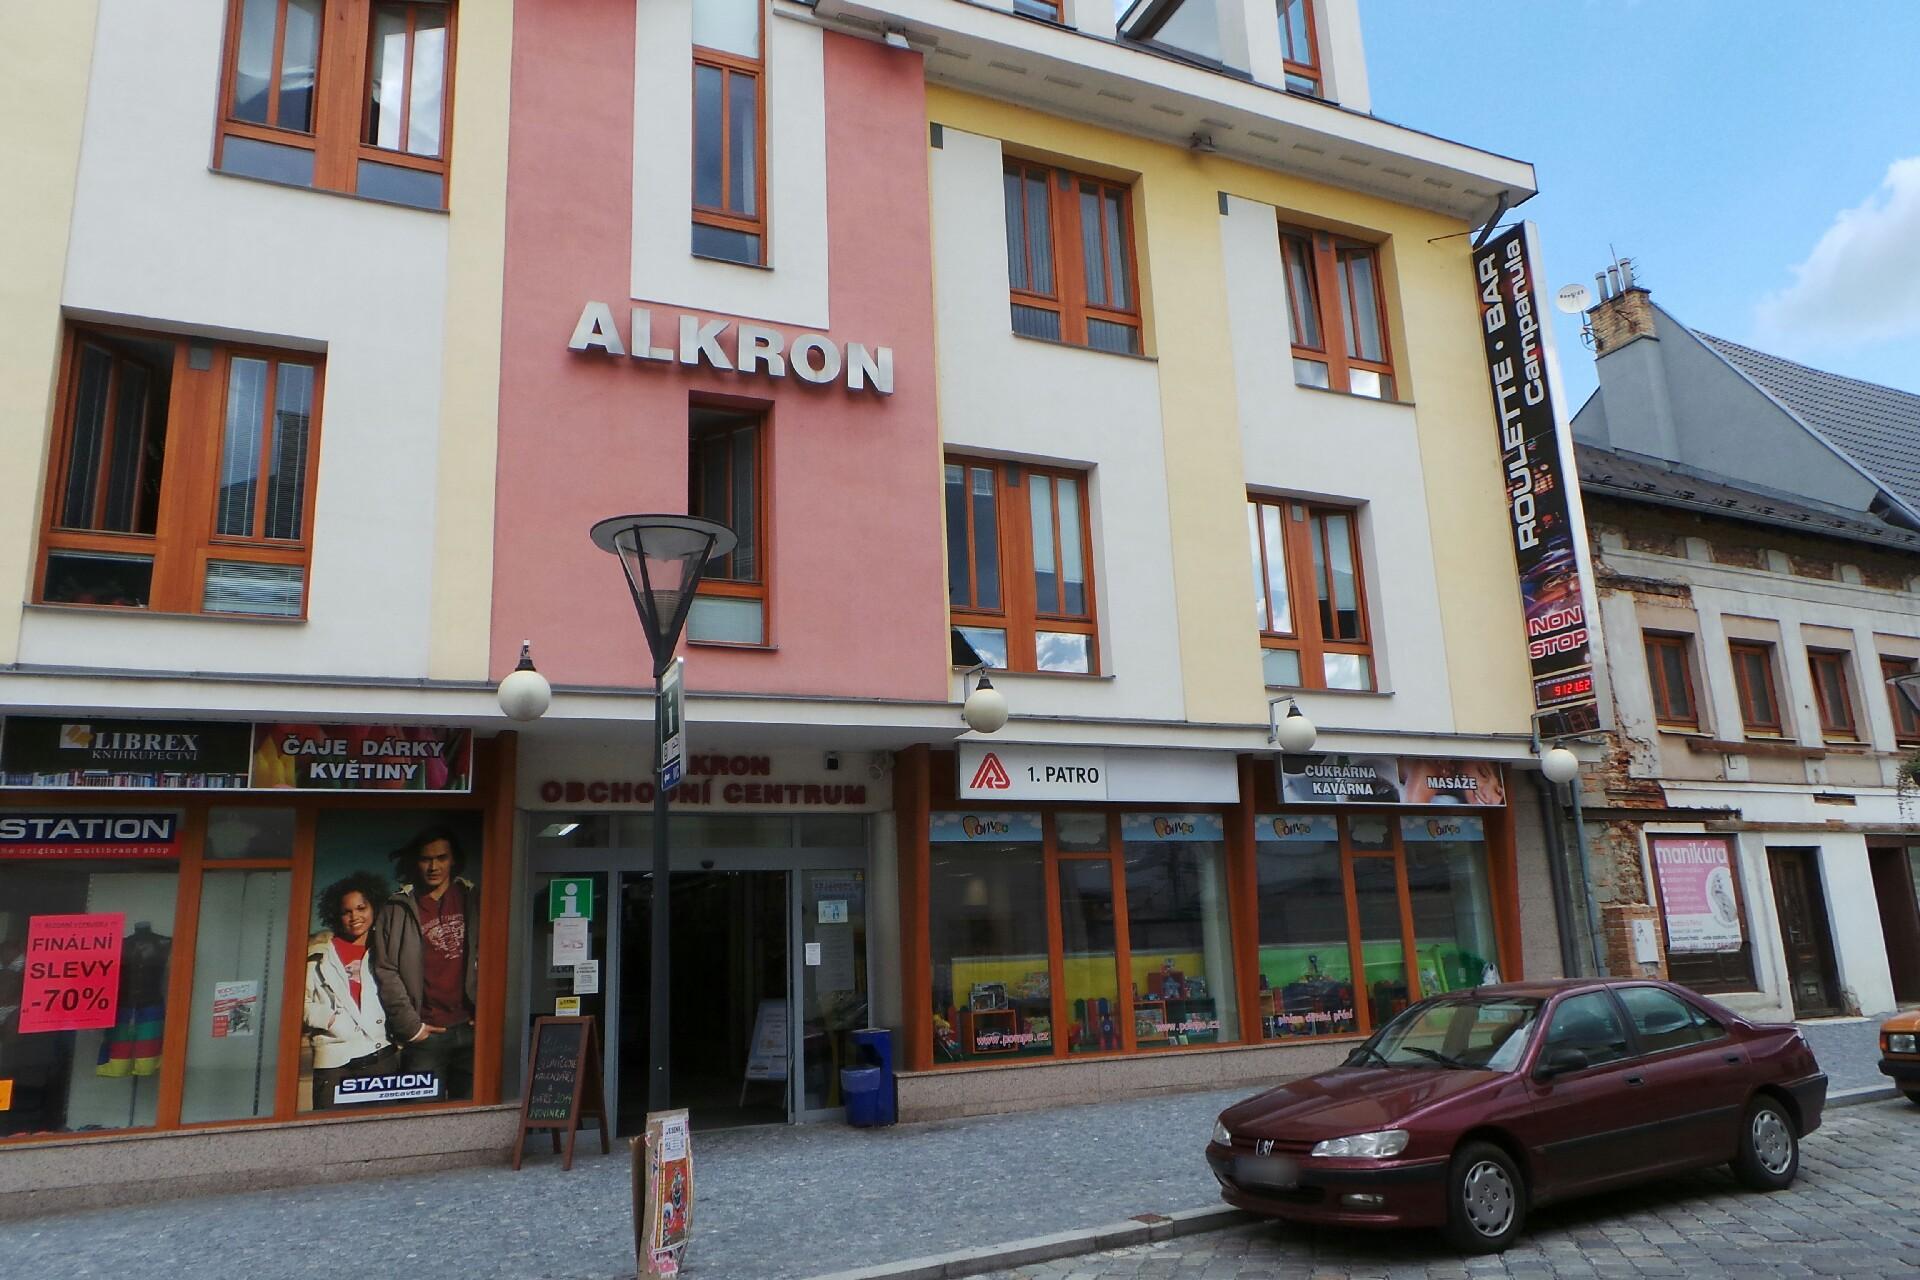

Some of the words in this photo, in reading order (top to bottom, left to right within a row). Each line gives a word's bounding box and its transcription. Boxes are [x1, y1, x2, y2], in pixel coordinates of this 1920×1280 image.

[1478, 252, 1506, 334] BAR
[1504, 238, 1545, 406] Campanula
[567, 301, 894, 395] ALKRON
[1492, 357, 1539, 550] ROULETTE
[1529, 604, 1583, 635] NON
[1529, 628, 1589, 659] STOP
[94, 732, 199, 751] LIBREX
[282, 735, 348, 756] ČAJE
[362, 737, 445, 757] DÁRKY
[92, 749, 198, 761] KNIHKUPECTVÍ
[310, 760, 418, 780] KVĚTINY
[1027, 766, 1041, 783] 1.
[1045, 766, 1099, 783] PATRO
[1304, 763, 1376, 779] CUKRÁRNA
[1312, 778, 1374, 795] KAVÁRNA
[1427, 775, 1478, 790] MASÁŽE
[723, 783, 867, 805] CENTRUM
[0, 818, 170, 839] STATION
[1655, 841, 1728, 864] manikúra
[32, 932, 113, 951] FINÁLNÍ
[30, 960, 114, 979] SLEVY
[31, 987, 109, 1012] -70%
[342, 1073, 432, 1092] STATION
